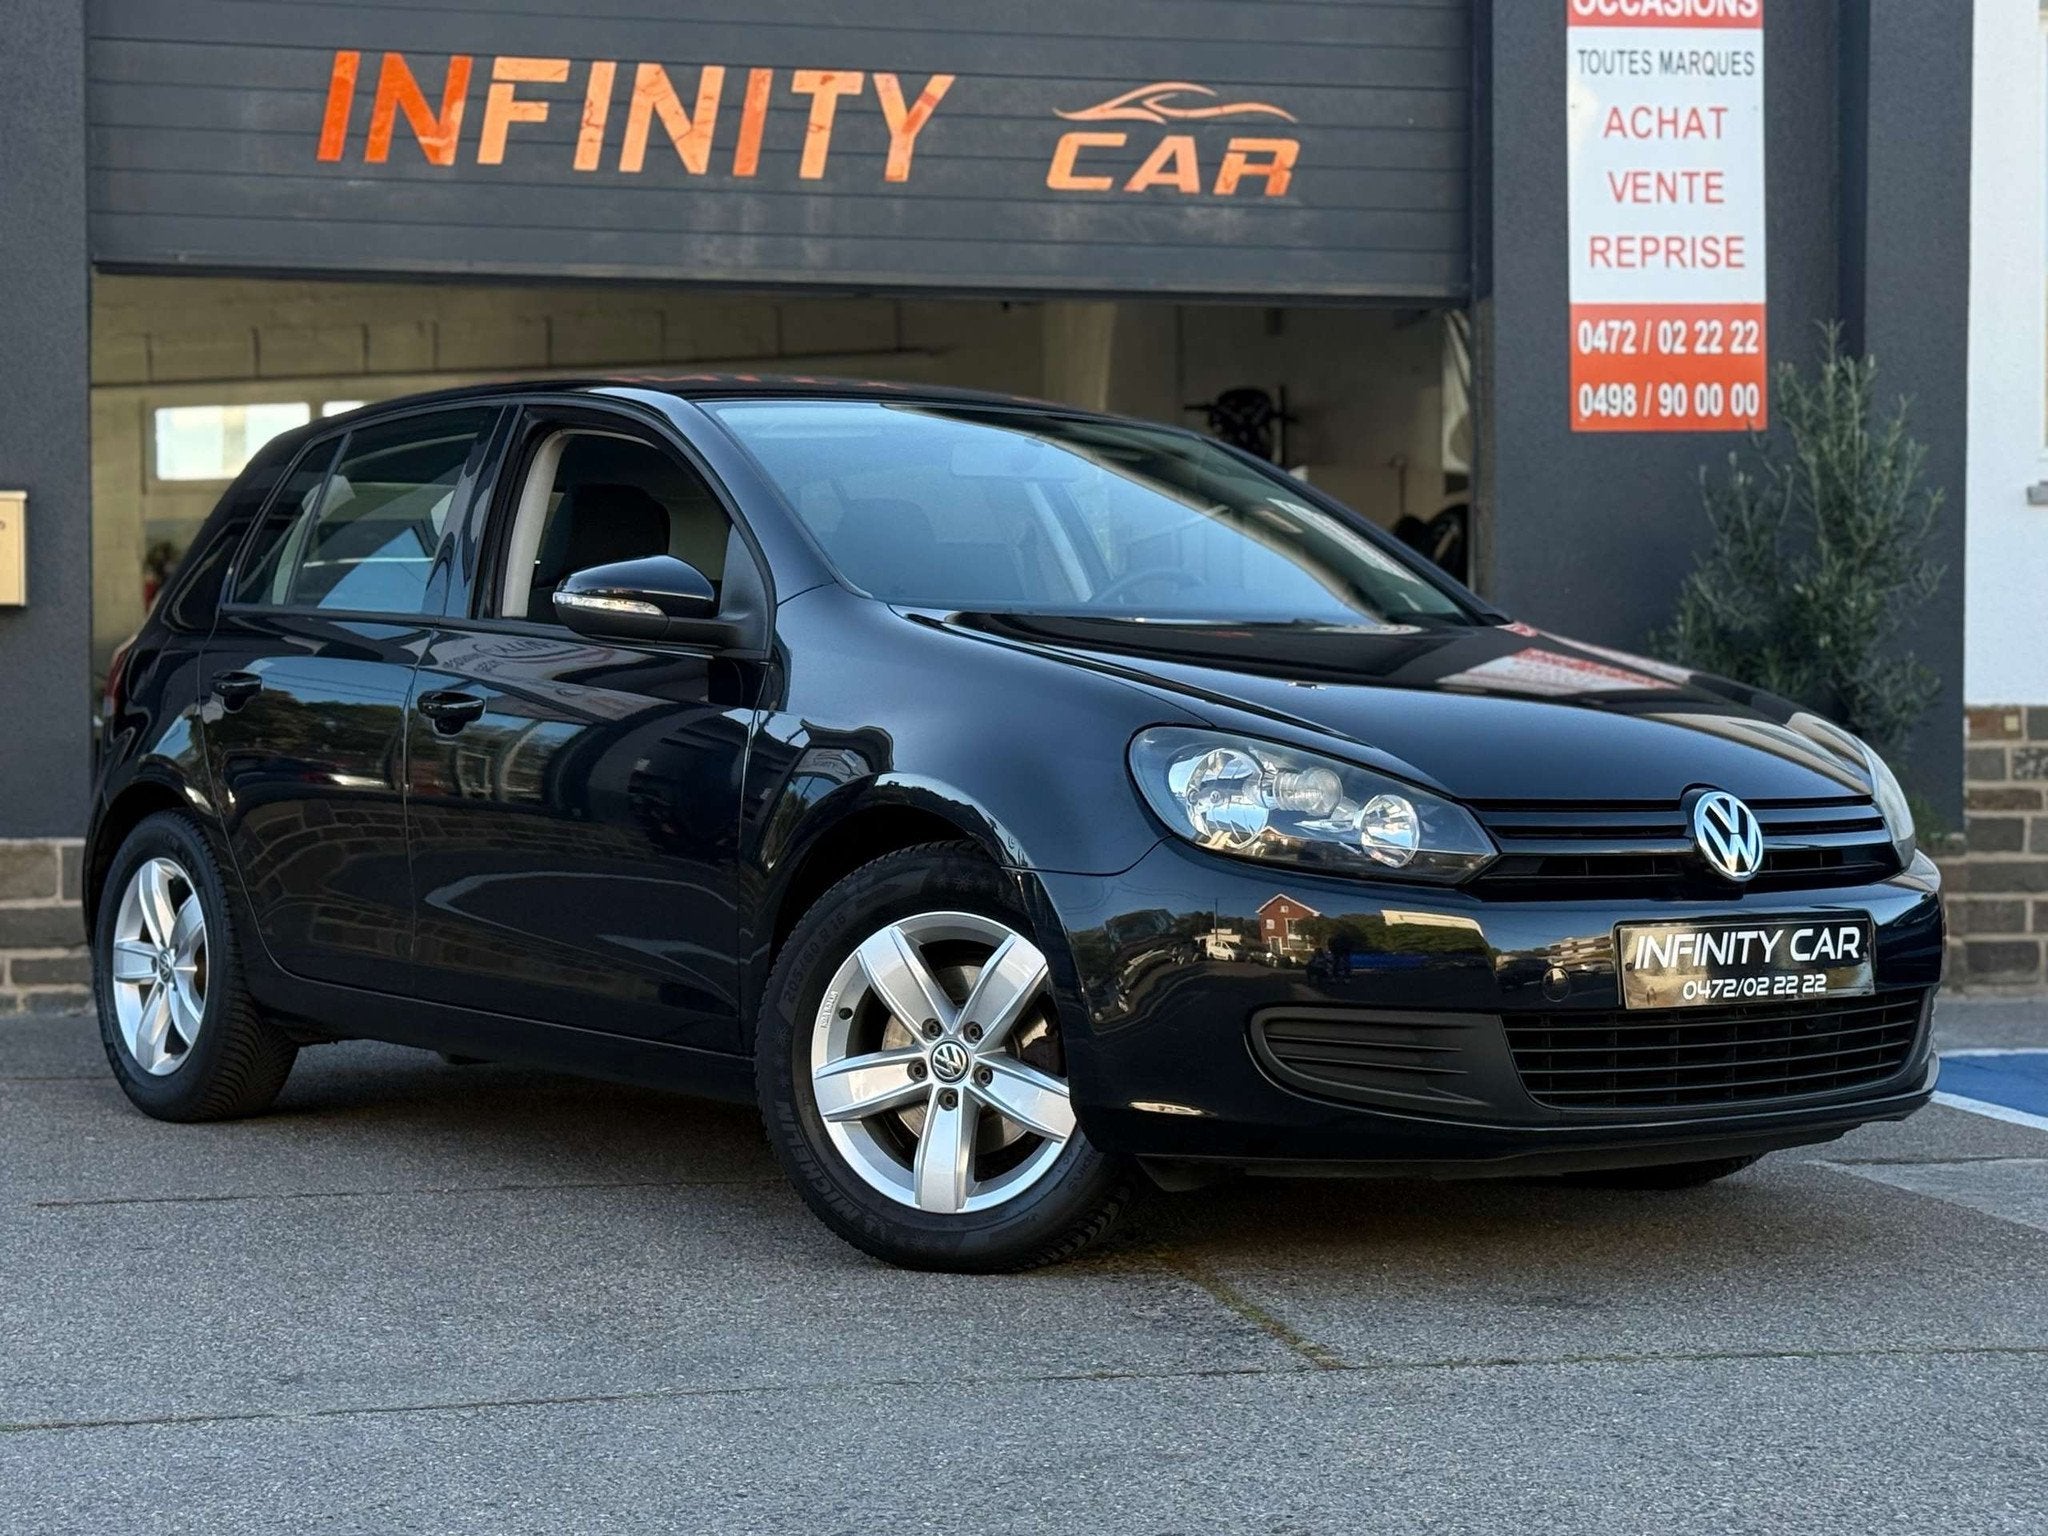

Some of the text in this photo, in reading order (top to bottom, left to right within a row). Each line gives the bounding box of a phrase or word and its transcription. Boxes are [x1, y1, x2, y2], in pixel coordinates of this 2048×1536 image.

[1578, 50, 1755, 76] TOUTES MARQUES
[316, 50, 1300, 195] INFINITY CAR
[1604, 107, 1728, 139] ACHAT
[1608, 172, 1724, 203] VENTE
[1590, 236, 1745, 268] REPRISE
[1578, 320, 1637, 354] 0472
[1658, 320, 1687, 354] 02
[1694, 320, 1724, 354] 22
[1730, 320, 1760, 354] 22
[1579, 383, 1637, 417] 0498
[1658, 383, 1687, 417] 90
[1694, 383, 1724, 417] 00
[1731, 383, 1760, 418] 00
[1634, 926, 1861, 970] INFINITY CAR
[1682, 973, 1827, 1000] 0472/02 22 22
